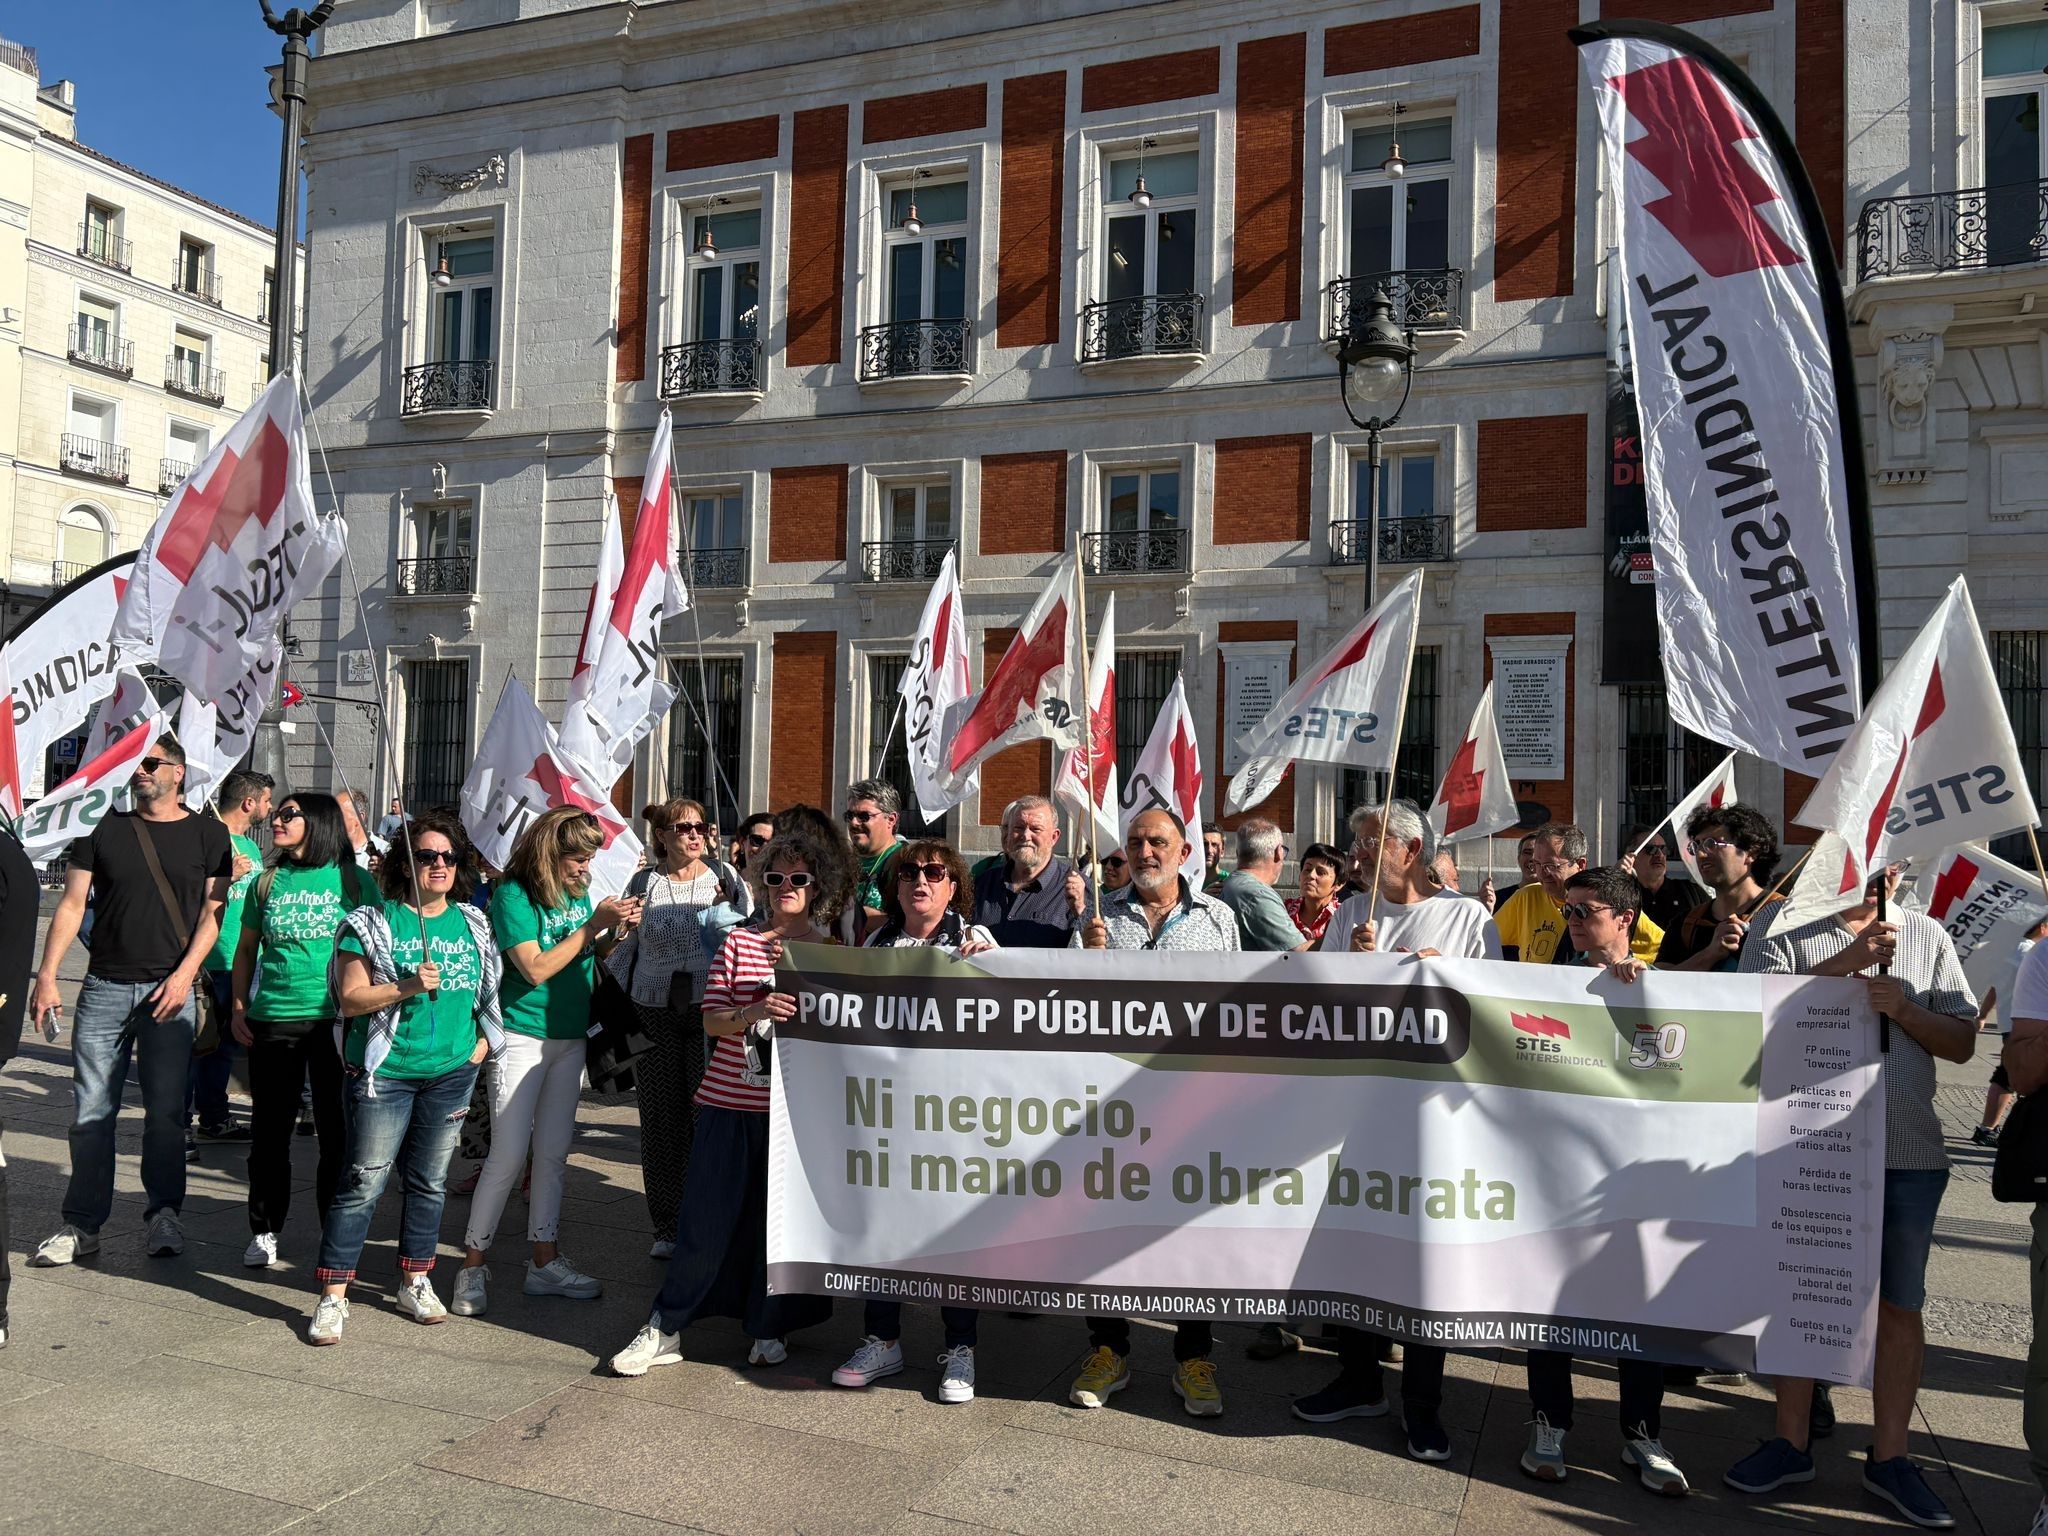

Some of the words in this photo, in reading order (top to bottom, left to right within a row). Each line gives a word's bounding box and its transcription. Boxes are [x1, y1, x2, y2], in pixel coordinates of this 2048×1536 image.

[798, 991, 863, 1029] POR
[875, 995, 944, 1032] UNA
[956, 998, 1000, 1033] FP
[1014, 989, 1173, 1037] PÚBLICA
[1182, 1002, 1207, 1037] Y
[1219, 1003, 1267, 1040] DE
[1281, 1004, 1449, 1045] CALIDAD
[1806, 1005, 1850, 1016] Voracidad
[1796, 1020, 1850, 1030] empresarial
[1515, 1037, 1561, 1053] STEs
[1629, 1022, 1687, 1069] 50
[1805, 1045, 1817, 1054] FP
[1819, 1046, 1851, 1056] online
[1516, 1052, 1607, 1068] INTERSINDICAL
[1790, 1084, 1836, 1097] Prácticas
[1839, 1089, 1852, 1098] en
[846, 1076, 893, 1129] Ni
[914, 1084, 1151, 1148] negocio,
[1788, 1099, 1821, 1110] primer
[1824, 1102, 1852, 1112] curso
[1790, 1125, 1843, 1139] Burocracia
[1845, 1131, 1852, 1141] y
[1795, 1139, 1825, 1151] ratios
[1827, 1141, 1852, 1153] altas
[846, 1138, 890, 1189] ni
[911, 1154, 1062, 1198] mano
[1083, 1147, 1151, 1202] de
[1172, 1151, 1304, 1206] obra
[1327, 1153, 1516, 1221] barata
[1799, 1166, 1837, 1180] Pérdida
[1839, 1170, 1852, 1180] de
[1782, 1179, 1811, 1191] horas
[1813, 1181, 1852, 1194] lectivas
[1781, 1206, 1852, 1222] Obsolescencia
[1771, 1220, 1784, 1230] de
[1786, 1221, 1801, 1231] los
[1804, 1223, 1843, 1236] equipos
[1786, 1234, 1852, 1250] instalaciones
[1778, 1262, 1852, 1278] Discriminación
[1798, 1277, 1833, 1290] laboral
[1836, 1281, 1852, 1293] del
[1792, 1291, 1852, 1307] profesorado
[824, 1272, 943, 1300] CONFEDERACIÓN
[948, 1284, 967, 1301] DE
[971, 1286, 1060, 1309] SINDICATOS
[1066, 1292, 1086, 1310] DE
[1090, 1294, 1217, 1315] TRABAJADORAS
[1220, 1298, 1230, 1315] Y
[1235, 1298, 1361, 1323] TRABAJADORES
[1365, 1307, 1384, 1327] DE
[1388, 1313, 1406, 1333] LA
[1411, 1317, 1504, 1340] ENSEÑANZA
[1510, 1323, 1643, 1353] INTERSINDICAL
[1790, 1317, 1824, 1331] Guetos
[1827, 1324, 1840, 1333] en
[1843, 1324, 1852, 1335] la
[1804, 1333, 1817, 1344] FP
[1820, 1335, 1852, 1349] básica
